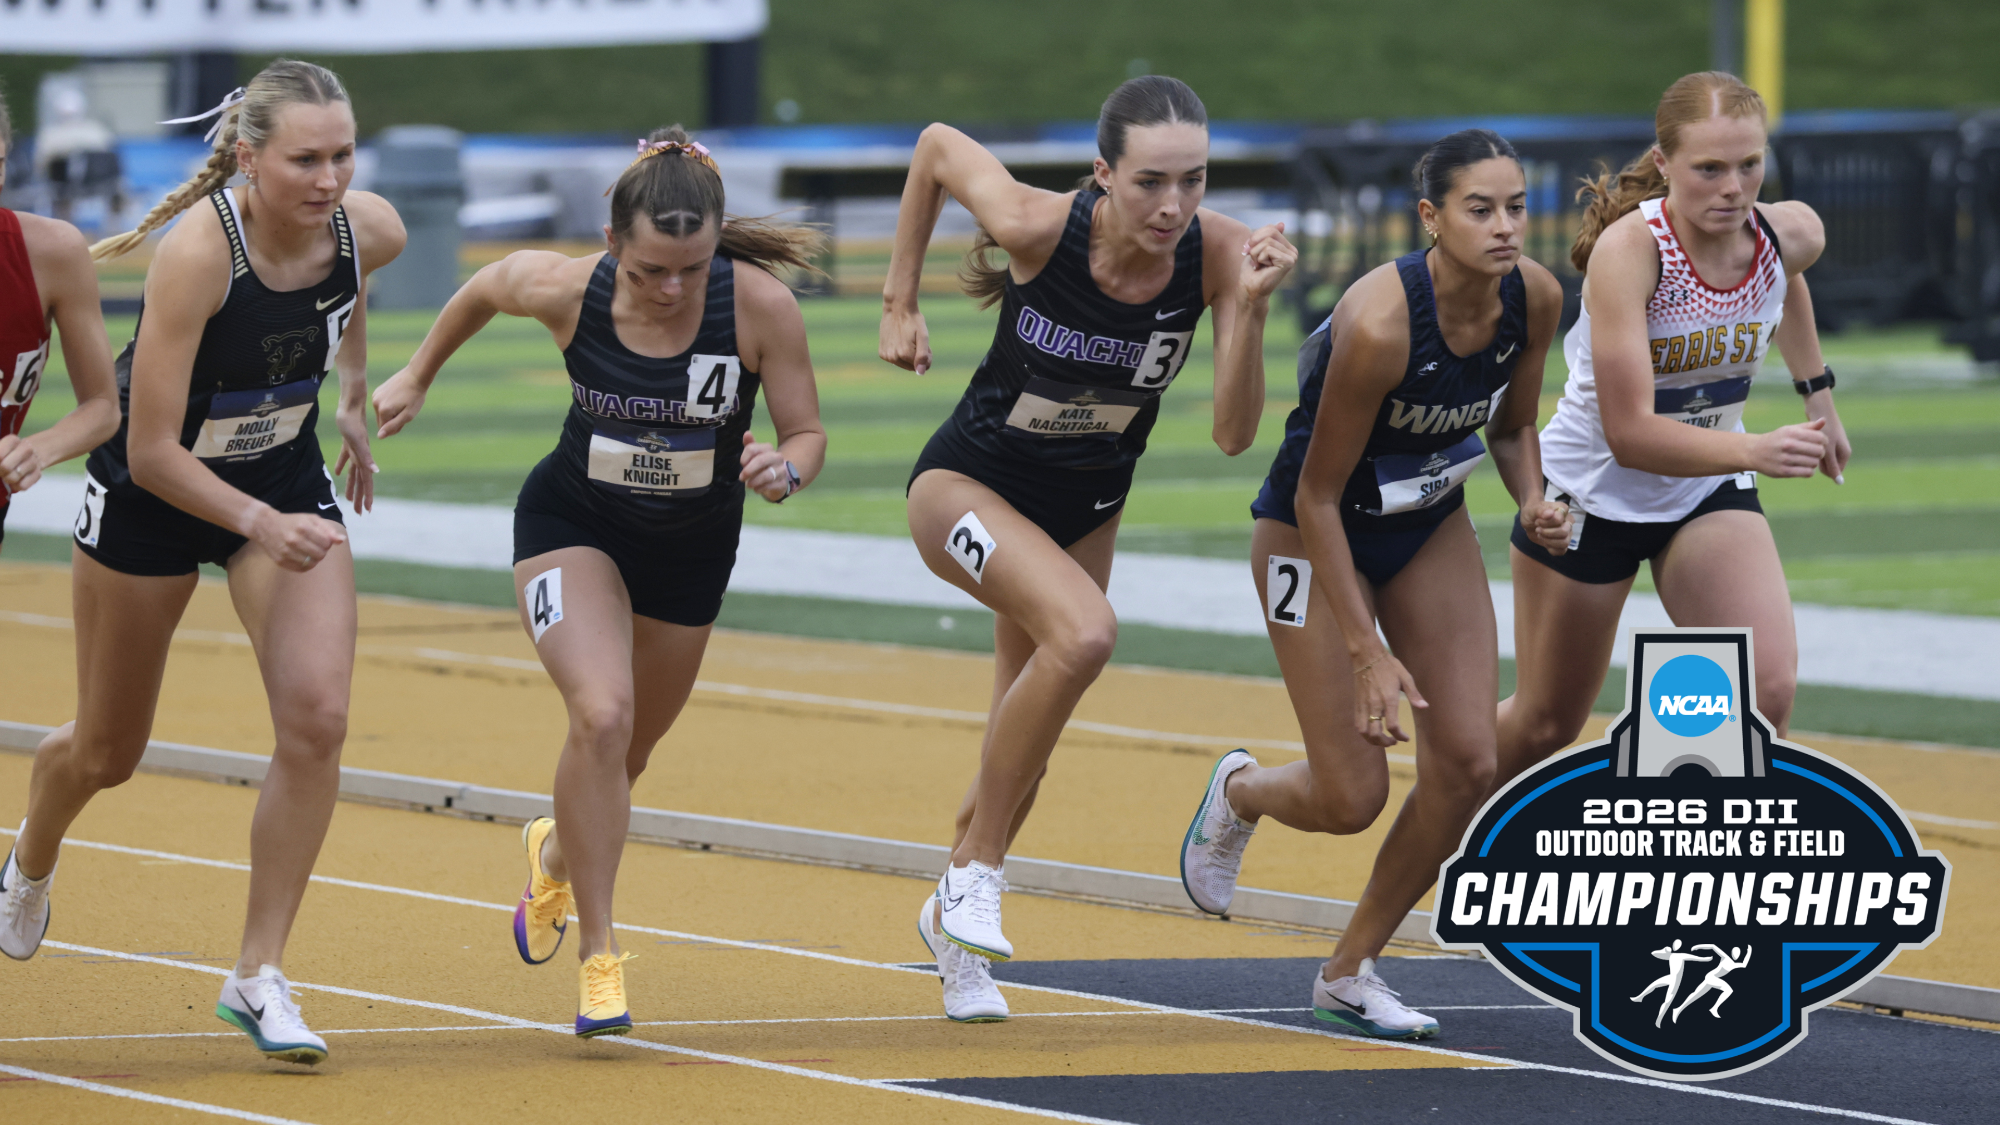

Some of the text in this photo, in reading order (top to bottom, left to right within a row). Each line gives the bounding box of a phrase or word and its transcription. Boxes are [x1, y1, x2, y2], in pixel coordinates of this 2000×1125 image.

[14, 351, 42, 404] 6
[1143, 338, 1180, 386] 3
[697, 363, 727, 415] 4
[235, 416, 280, 436] MOLLY
[1028, 418, 1109, 432] NACHTIGAL
[1058, 408, 1096, 420] KATE
[224, 433, 276, 453] BREUER
[623, 468, 681, 486] KNIGHT
[632, 453, 672, 471] ELISE
[1420, 476, 1449, 499] SIRA
[78, 482, 97, 539] 5
[952, 526, 984, 574] 3
[534, 577, 553, 627] 4
[1274, 563, 1299, 622] 2
